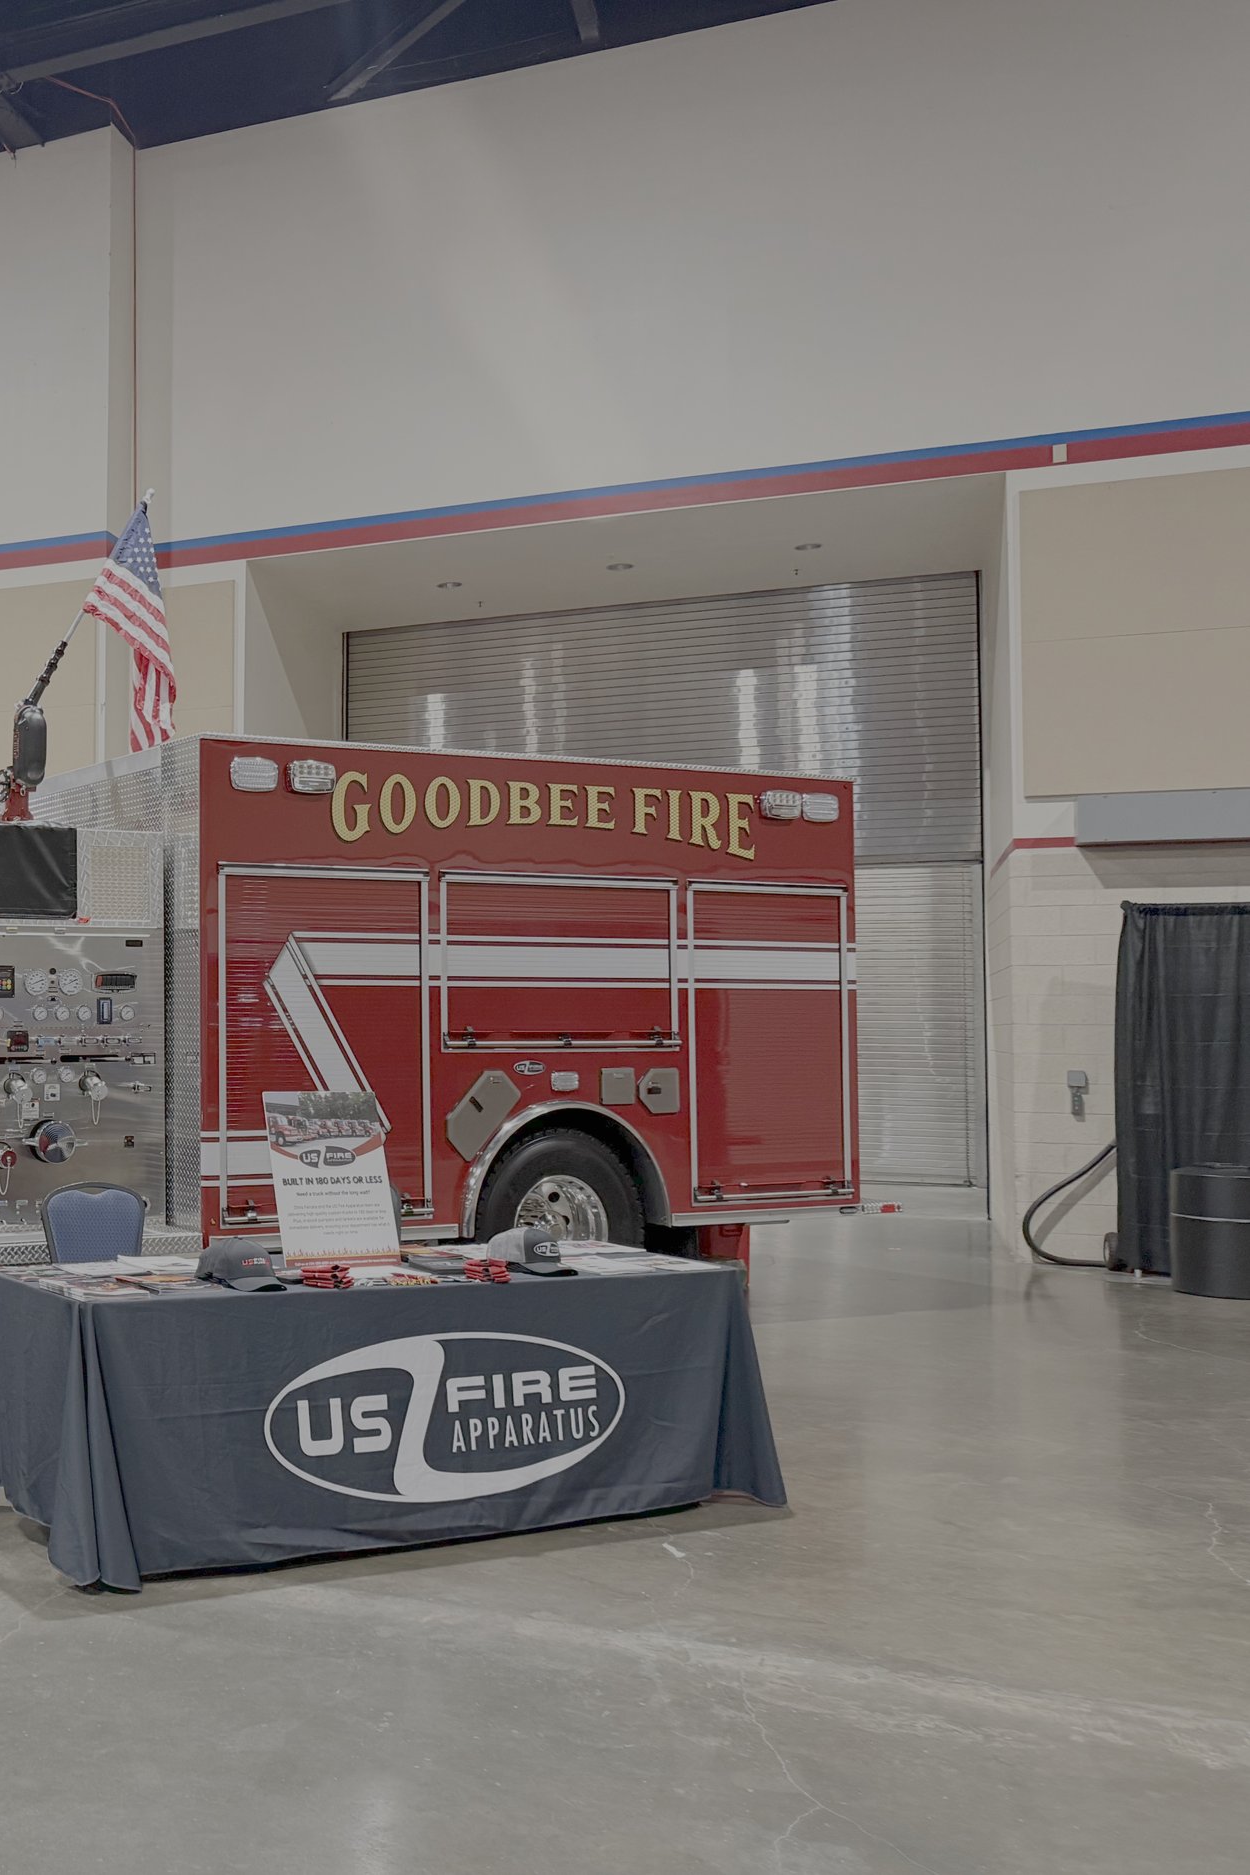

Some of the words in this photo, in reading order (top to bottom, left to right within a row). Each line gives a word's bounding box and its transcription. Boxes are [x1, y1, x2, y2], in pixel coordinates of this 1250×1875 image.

[331, 771, 616, 842] GOODBEE
[630, 788, 756, 861] FIRE
[282, 1177, 303, 1186] BUILT
[305, 1177, 314, 1185] IN
[316, 1177, 329, 1185] 180
[330, 1176, 351, 1185] DAYS
[352, 1176, 365, 1184] OR
[365, 1175, 383, 1184] LESS
[302, 1152, 319, 1163] US
[297, 1394, 393, 1457] US
[446, 1365, 597, 1413] FIRE
[452, 1405, 600, 1453] APPARATUS
